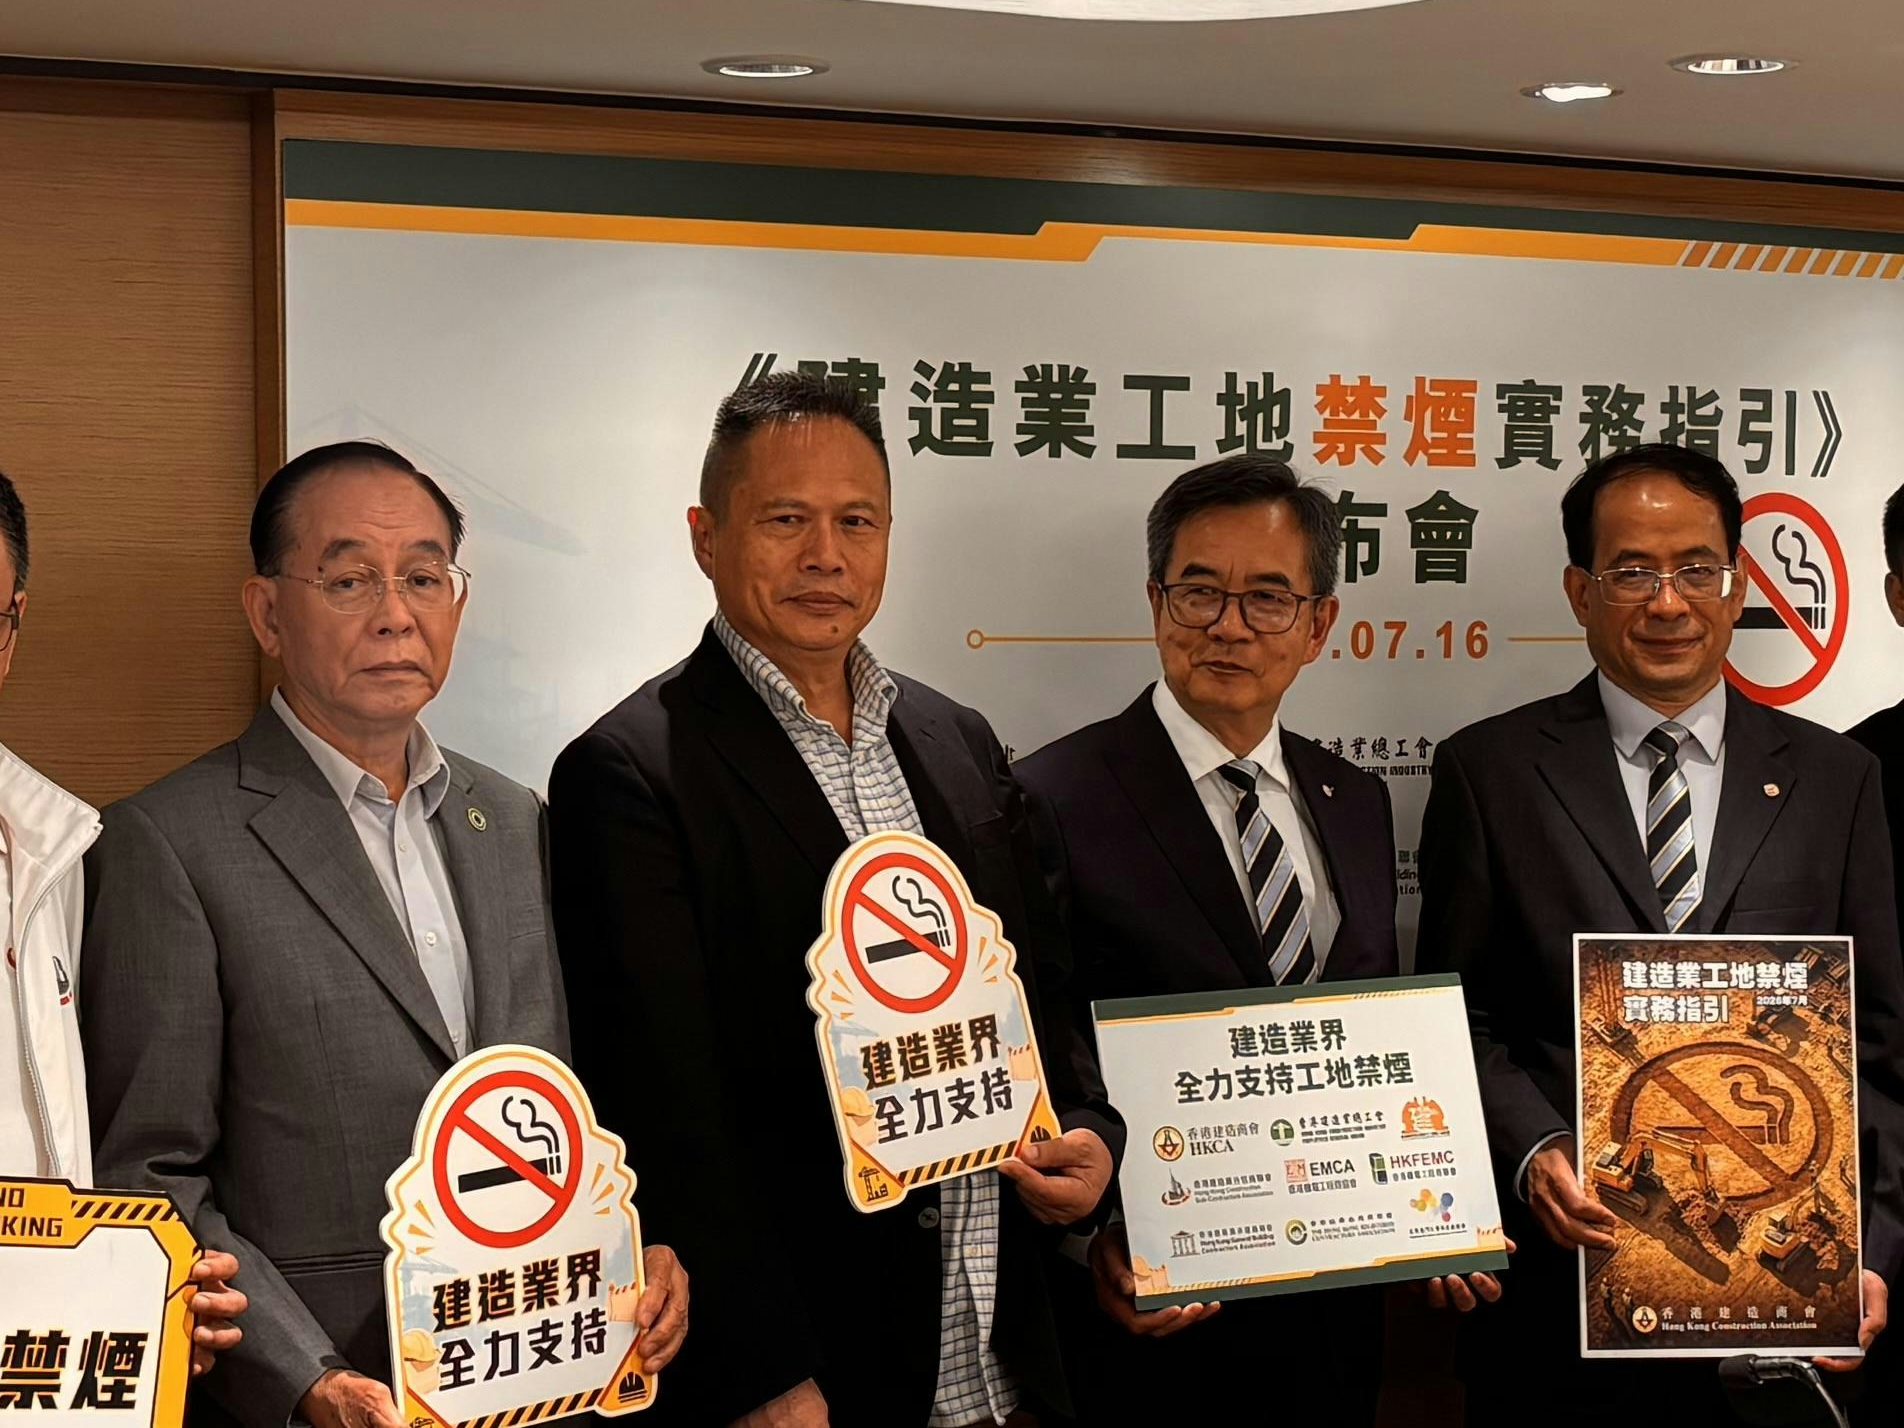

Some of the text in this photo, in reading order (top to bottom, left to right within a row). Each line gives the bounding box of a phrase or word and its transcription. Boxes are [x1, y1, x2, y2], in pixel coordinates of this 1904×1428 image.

[1334, 489, 1480, 584] 布會
[1331, 619, 1489, 660] .07.16
[1312, 736, 1434, 761] 造業總工會
[1622, 961, 1809, 989] 建造業工地禁煙
[1623, 994, 1729, 1022] 實務指引
[859, 1013, 1001, 1091] 建造業界
[1227, 1018, 1348, 1059] 建造業界
[1174, 1052, 1414, 1104] 全力支持工地禁煙
[874, 1066, 1014, 1145] 全力支持
[1189, 1140, 1234, 1156] HKCA
[1310, 1158, 1356, 1176] EMCA
[1389, 1150, 1456, 1170] HKFEMC
[432, 1247, 602, 1334] 建造業界
[1661, 1322, 1685, 1332] Hong
[1687, 1321, 1710, 1332] Kong
[1712, 1321, 1768, 1331] Construction
[439, 1306, 607, 1392] 全力支持
